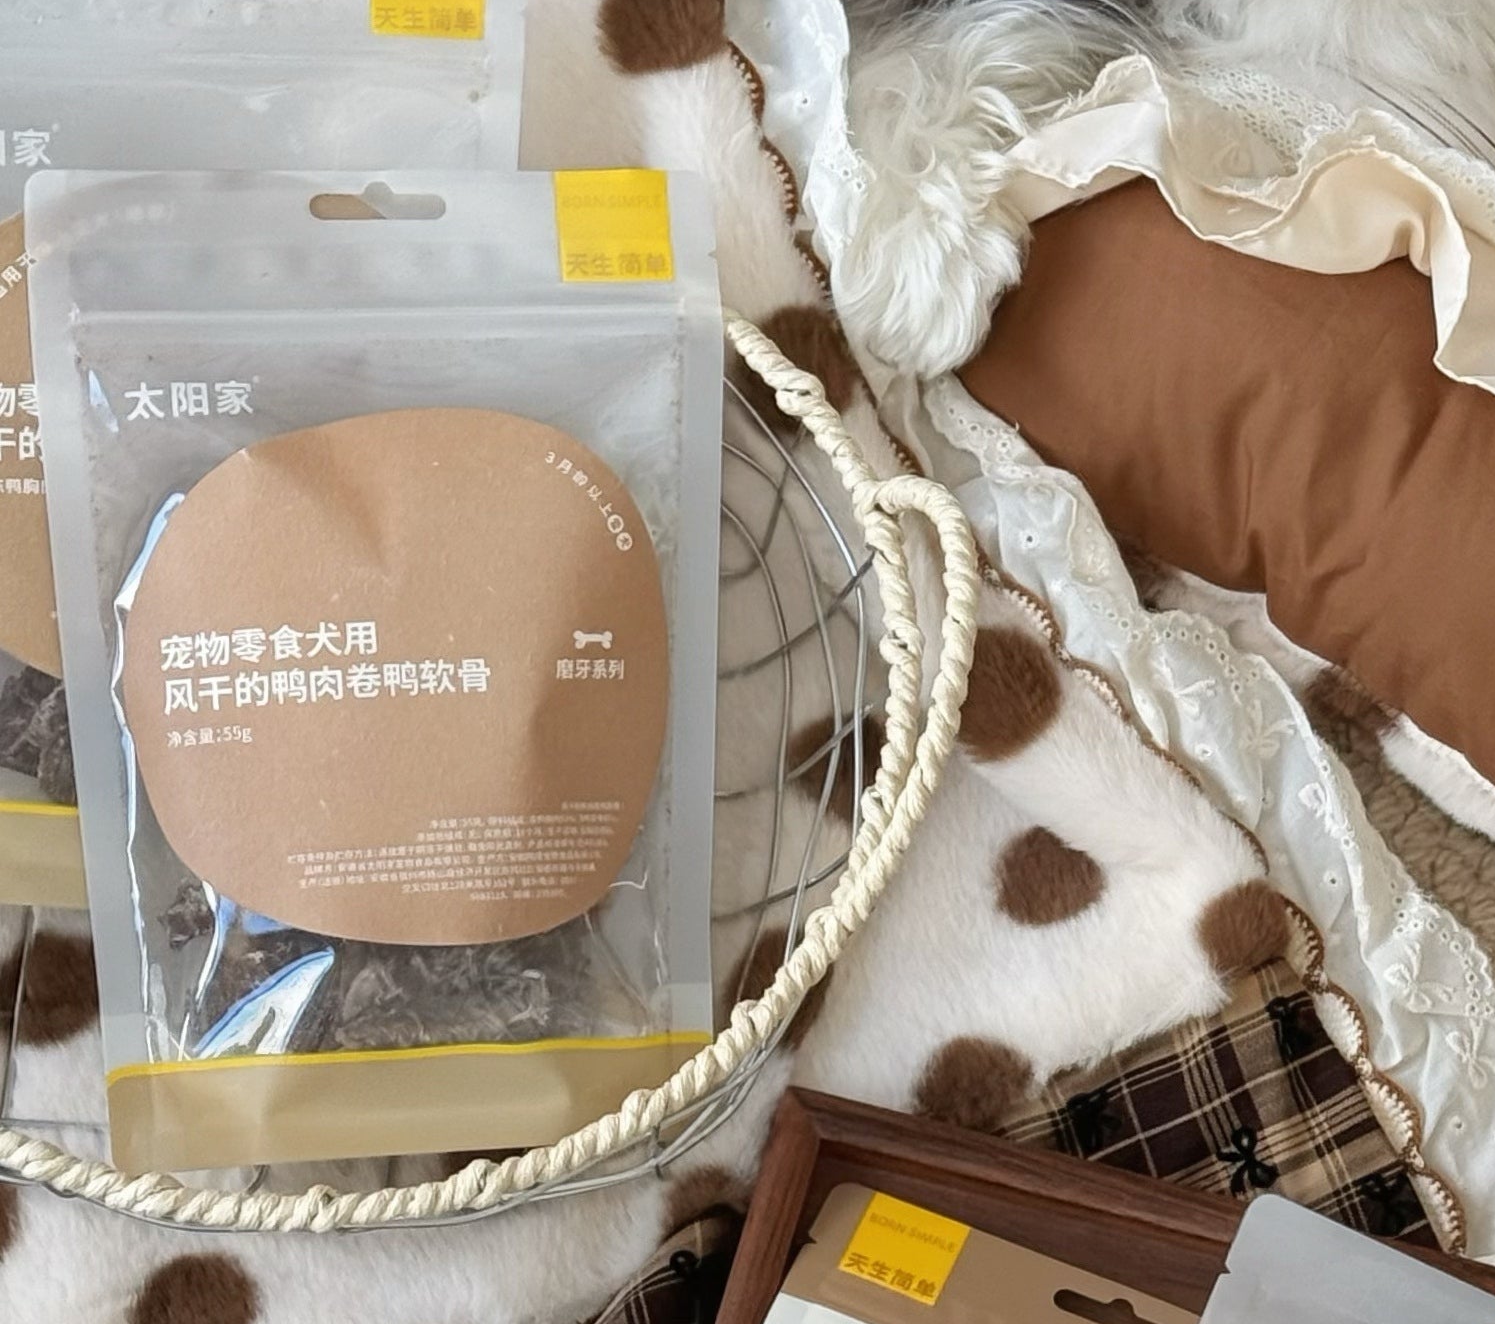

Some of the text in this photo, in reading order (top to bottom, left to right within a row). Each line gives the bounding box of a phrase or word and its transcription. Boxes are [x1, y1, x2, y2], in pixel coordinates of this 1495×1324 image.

[375, 6, 478, 33] 天生简单
[566, 252, 669, 276] 天生简单
[124, 380, 254, 422] 太阳家
[161, 621, 379, 672] 宠物零食犬用
[164, 660, 491, 715] 风干的鸭肉卷鸭软骨
[556, 658, 625, 681] 磨牙系列
[845, 1252, 936, 1298] 天生简单
